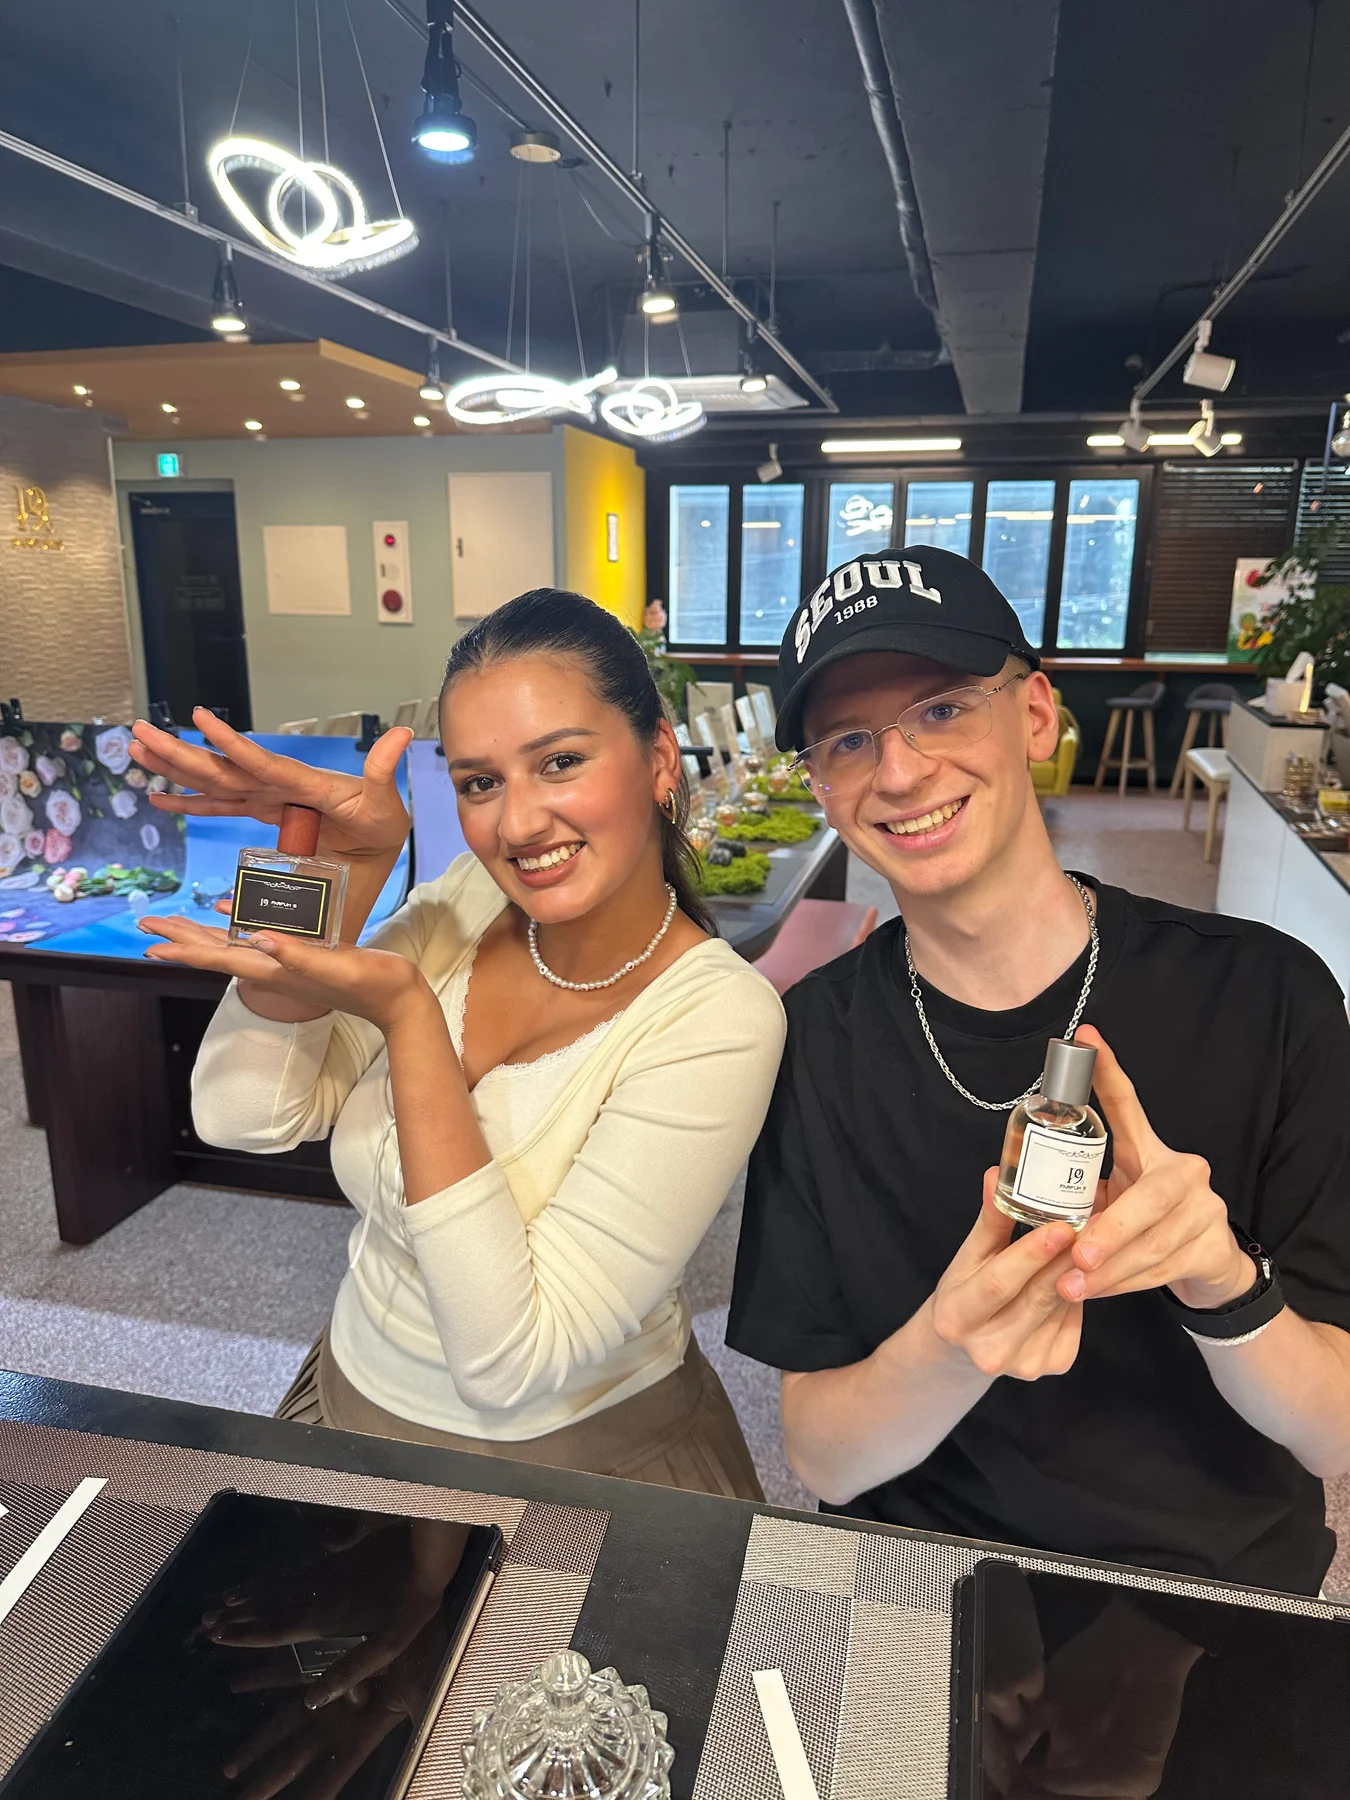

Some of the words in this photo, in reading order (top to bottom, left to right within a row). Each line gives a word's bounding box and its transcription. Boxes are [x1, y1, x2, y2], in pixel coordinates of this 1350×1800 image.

[795, 560, 941, 664] SEOUL
[834, 595, 878, 625] 1988
[1066, 1168, 1084, 1184] 19
